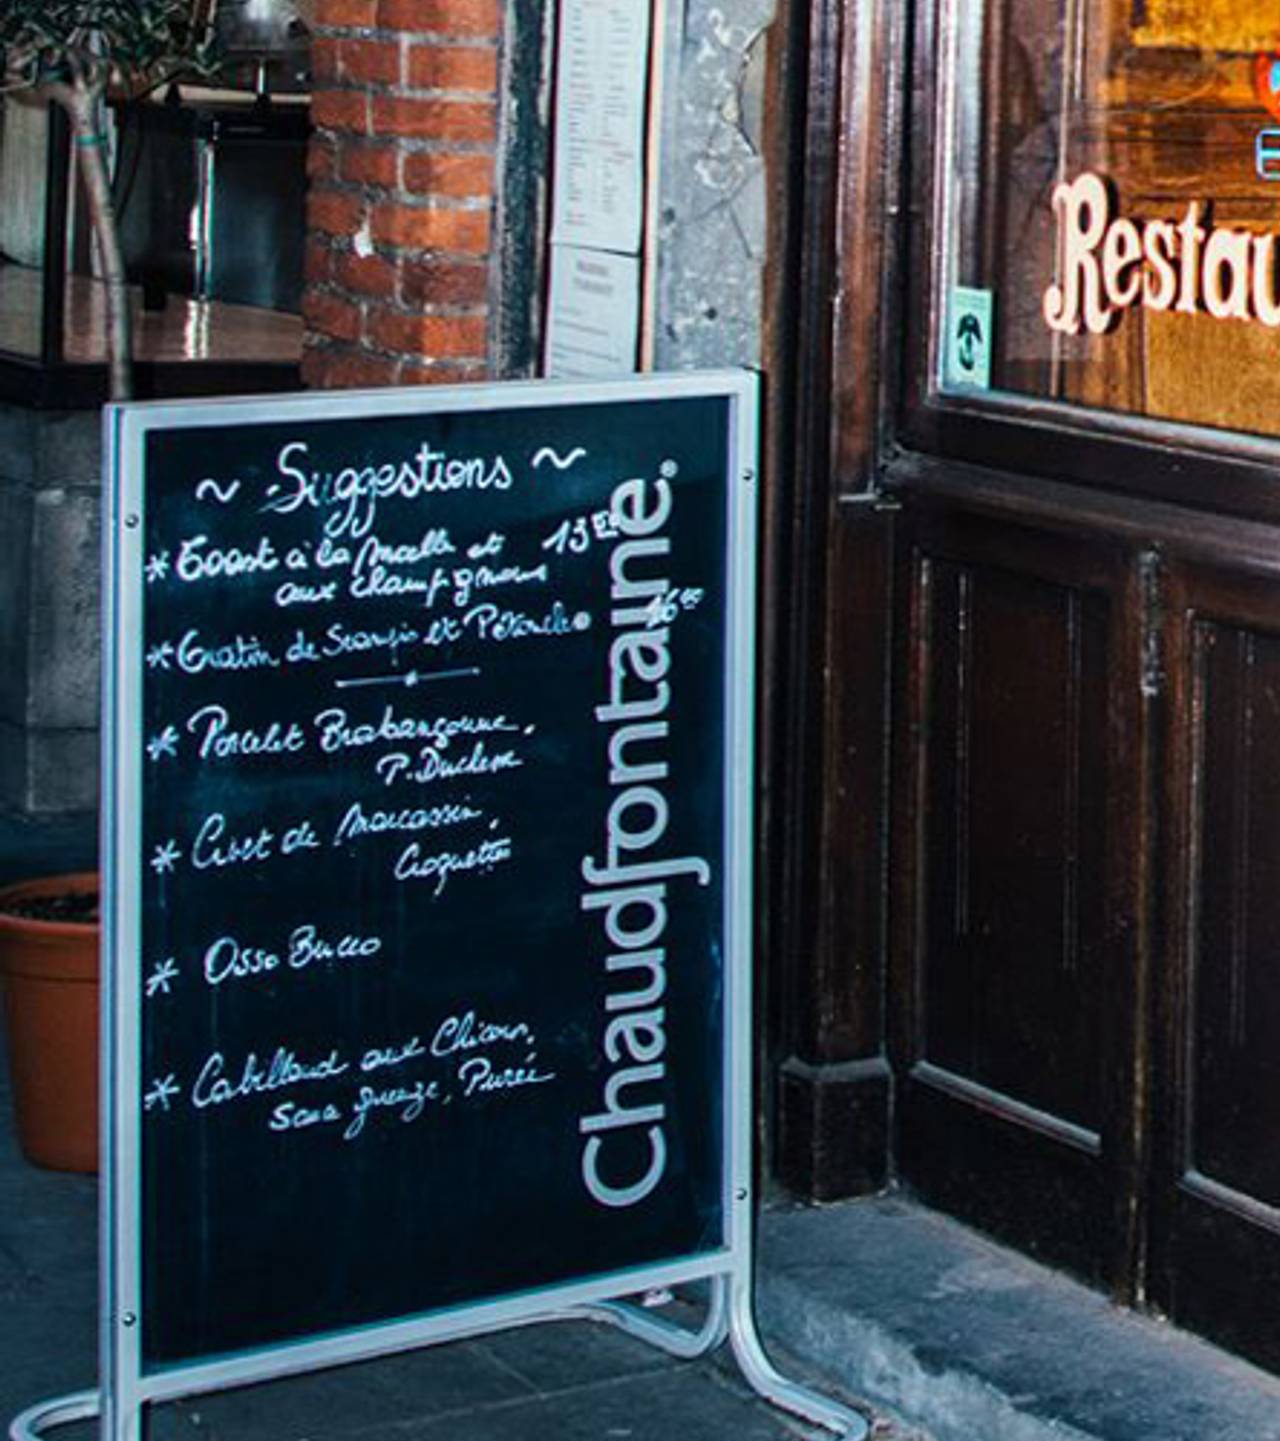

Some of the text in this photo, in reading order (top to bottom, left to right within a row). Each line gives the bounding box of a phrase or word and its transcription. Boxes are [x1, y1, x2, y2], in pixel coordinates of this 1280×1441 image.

[262, 442, 513, 538] Suggestions
[176, 629, 281, 673] Gratin
[285, 631, 320, 663] de
[280, 821, 321, 855] de
[580, 477, 712, 1208] Chaudfontaine
[204, 936, 280, 985] Osso
